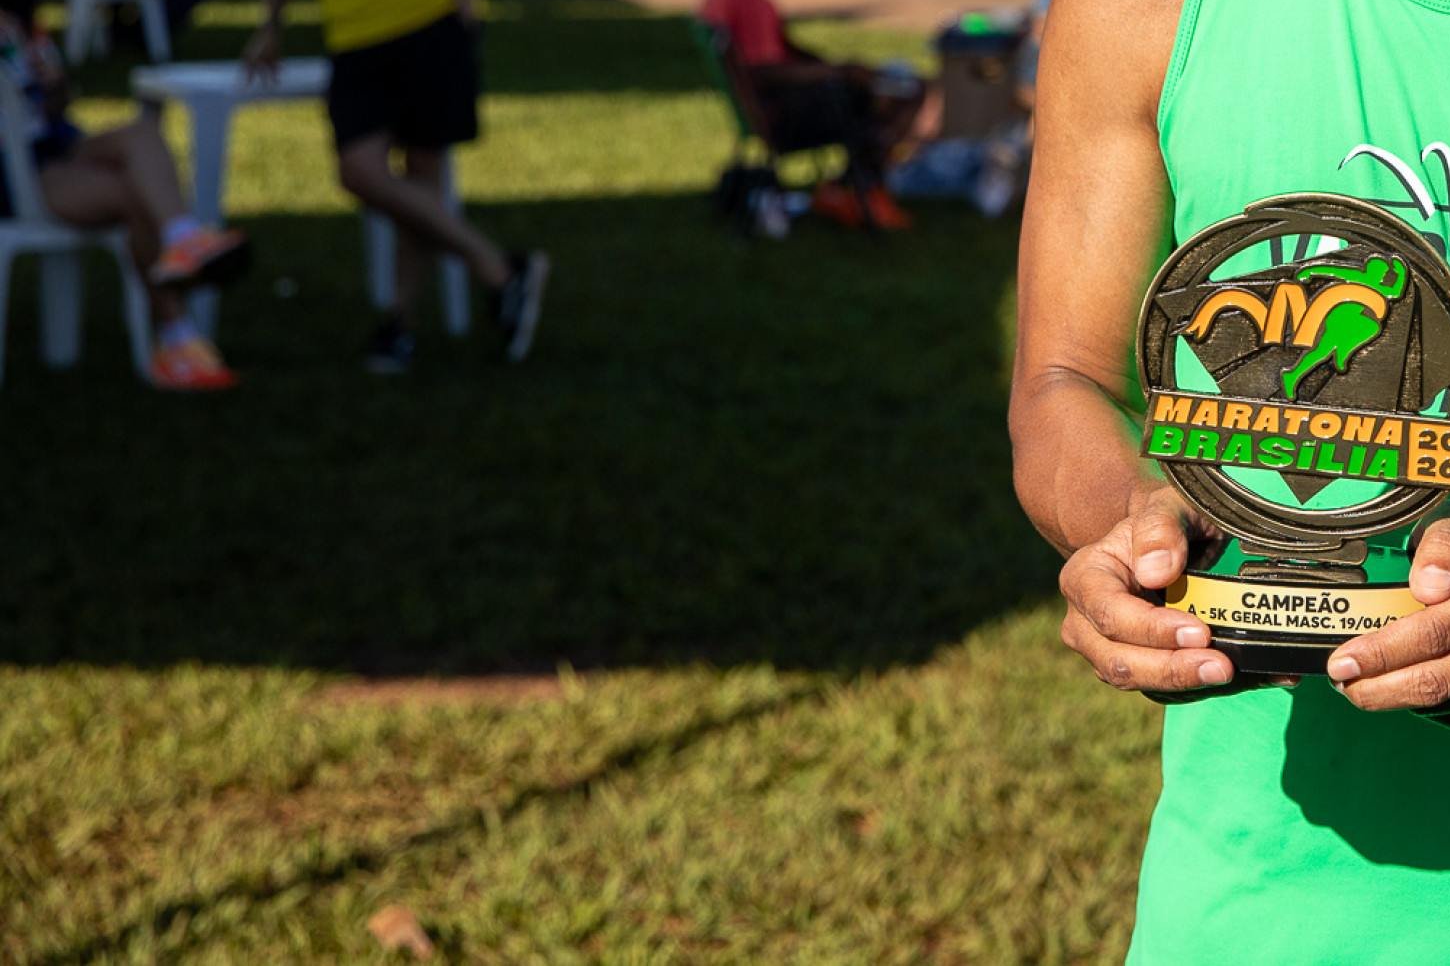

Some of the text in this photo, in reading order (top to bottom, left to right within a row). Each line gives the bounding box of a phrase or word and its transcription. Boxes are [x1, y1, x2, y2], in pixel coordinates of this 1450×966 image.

[1153, 395, 1403, 446] MARATONA
[1241, 592, 1350, 614] CAMPEÃO
[1209, 607, 1228, 621] 5K
[1231, 610, 1282, 626] GERAL
[1286, 615, 1336, 630] MASC.
